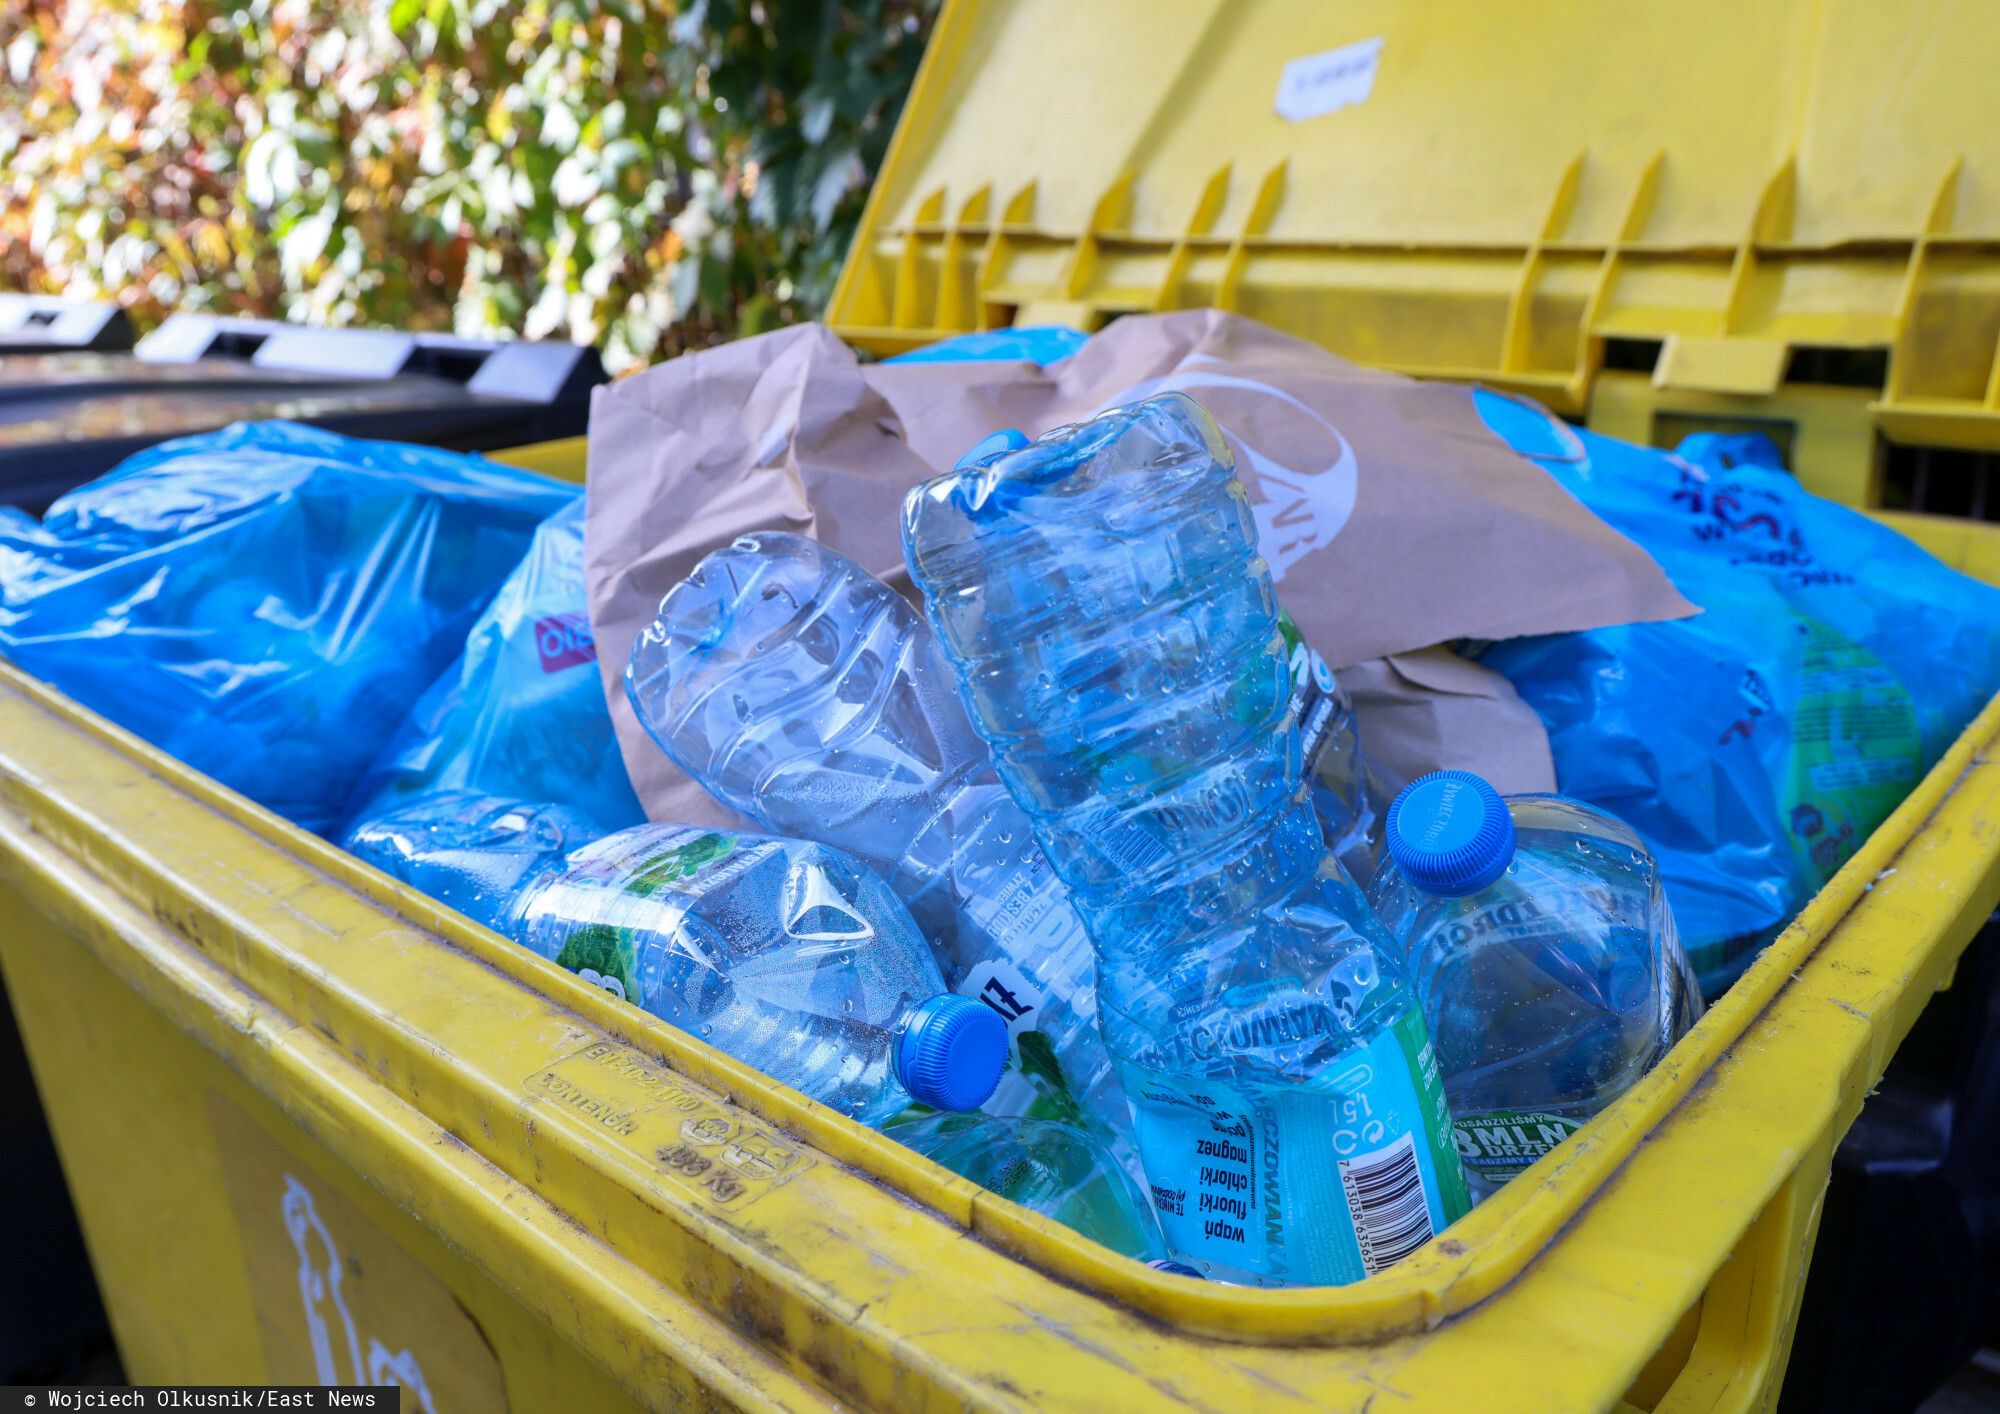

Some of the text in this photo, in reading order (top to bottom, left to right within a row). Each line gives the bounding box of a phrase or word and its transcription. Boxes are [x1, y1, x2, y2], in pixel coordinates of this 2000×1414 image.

[1473, 1123, 1568, 1146] MLN
[1197, 1139, 1247, 1164] magnez
[1200, 1165, 1248, 1191] chlorki
[1200, 1193, 1247, 1221] fluorki
[1204, 1219, 1245, 1243] wapń
[1343, 1176, 1363, 1221] 613038
[1356, 1227, 1375, 1271] 635651
